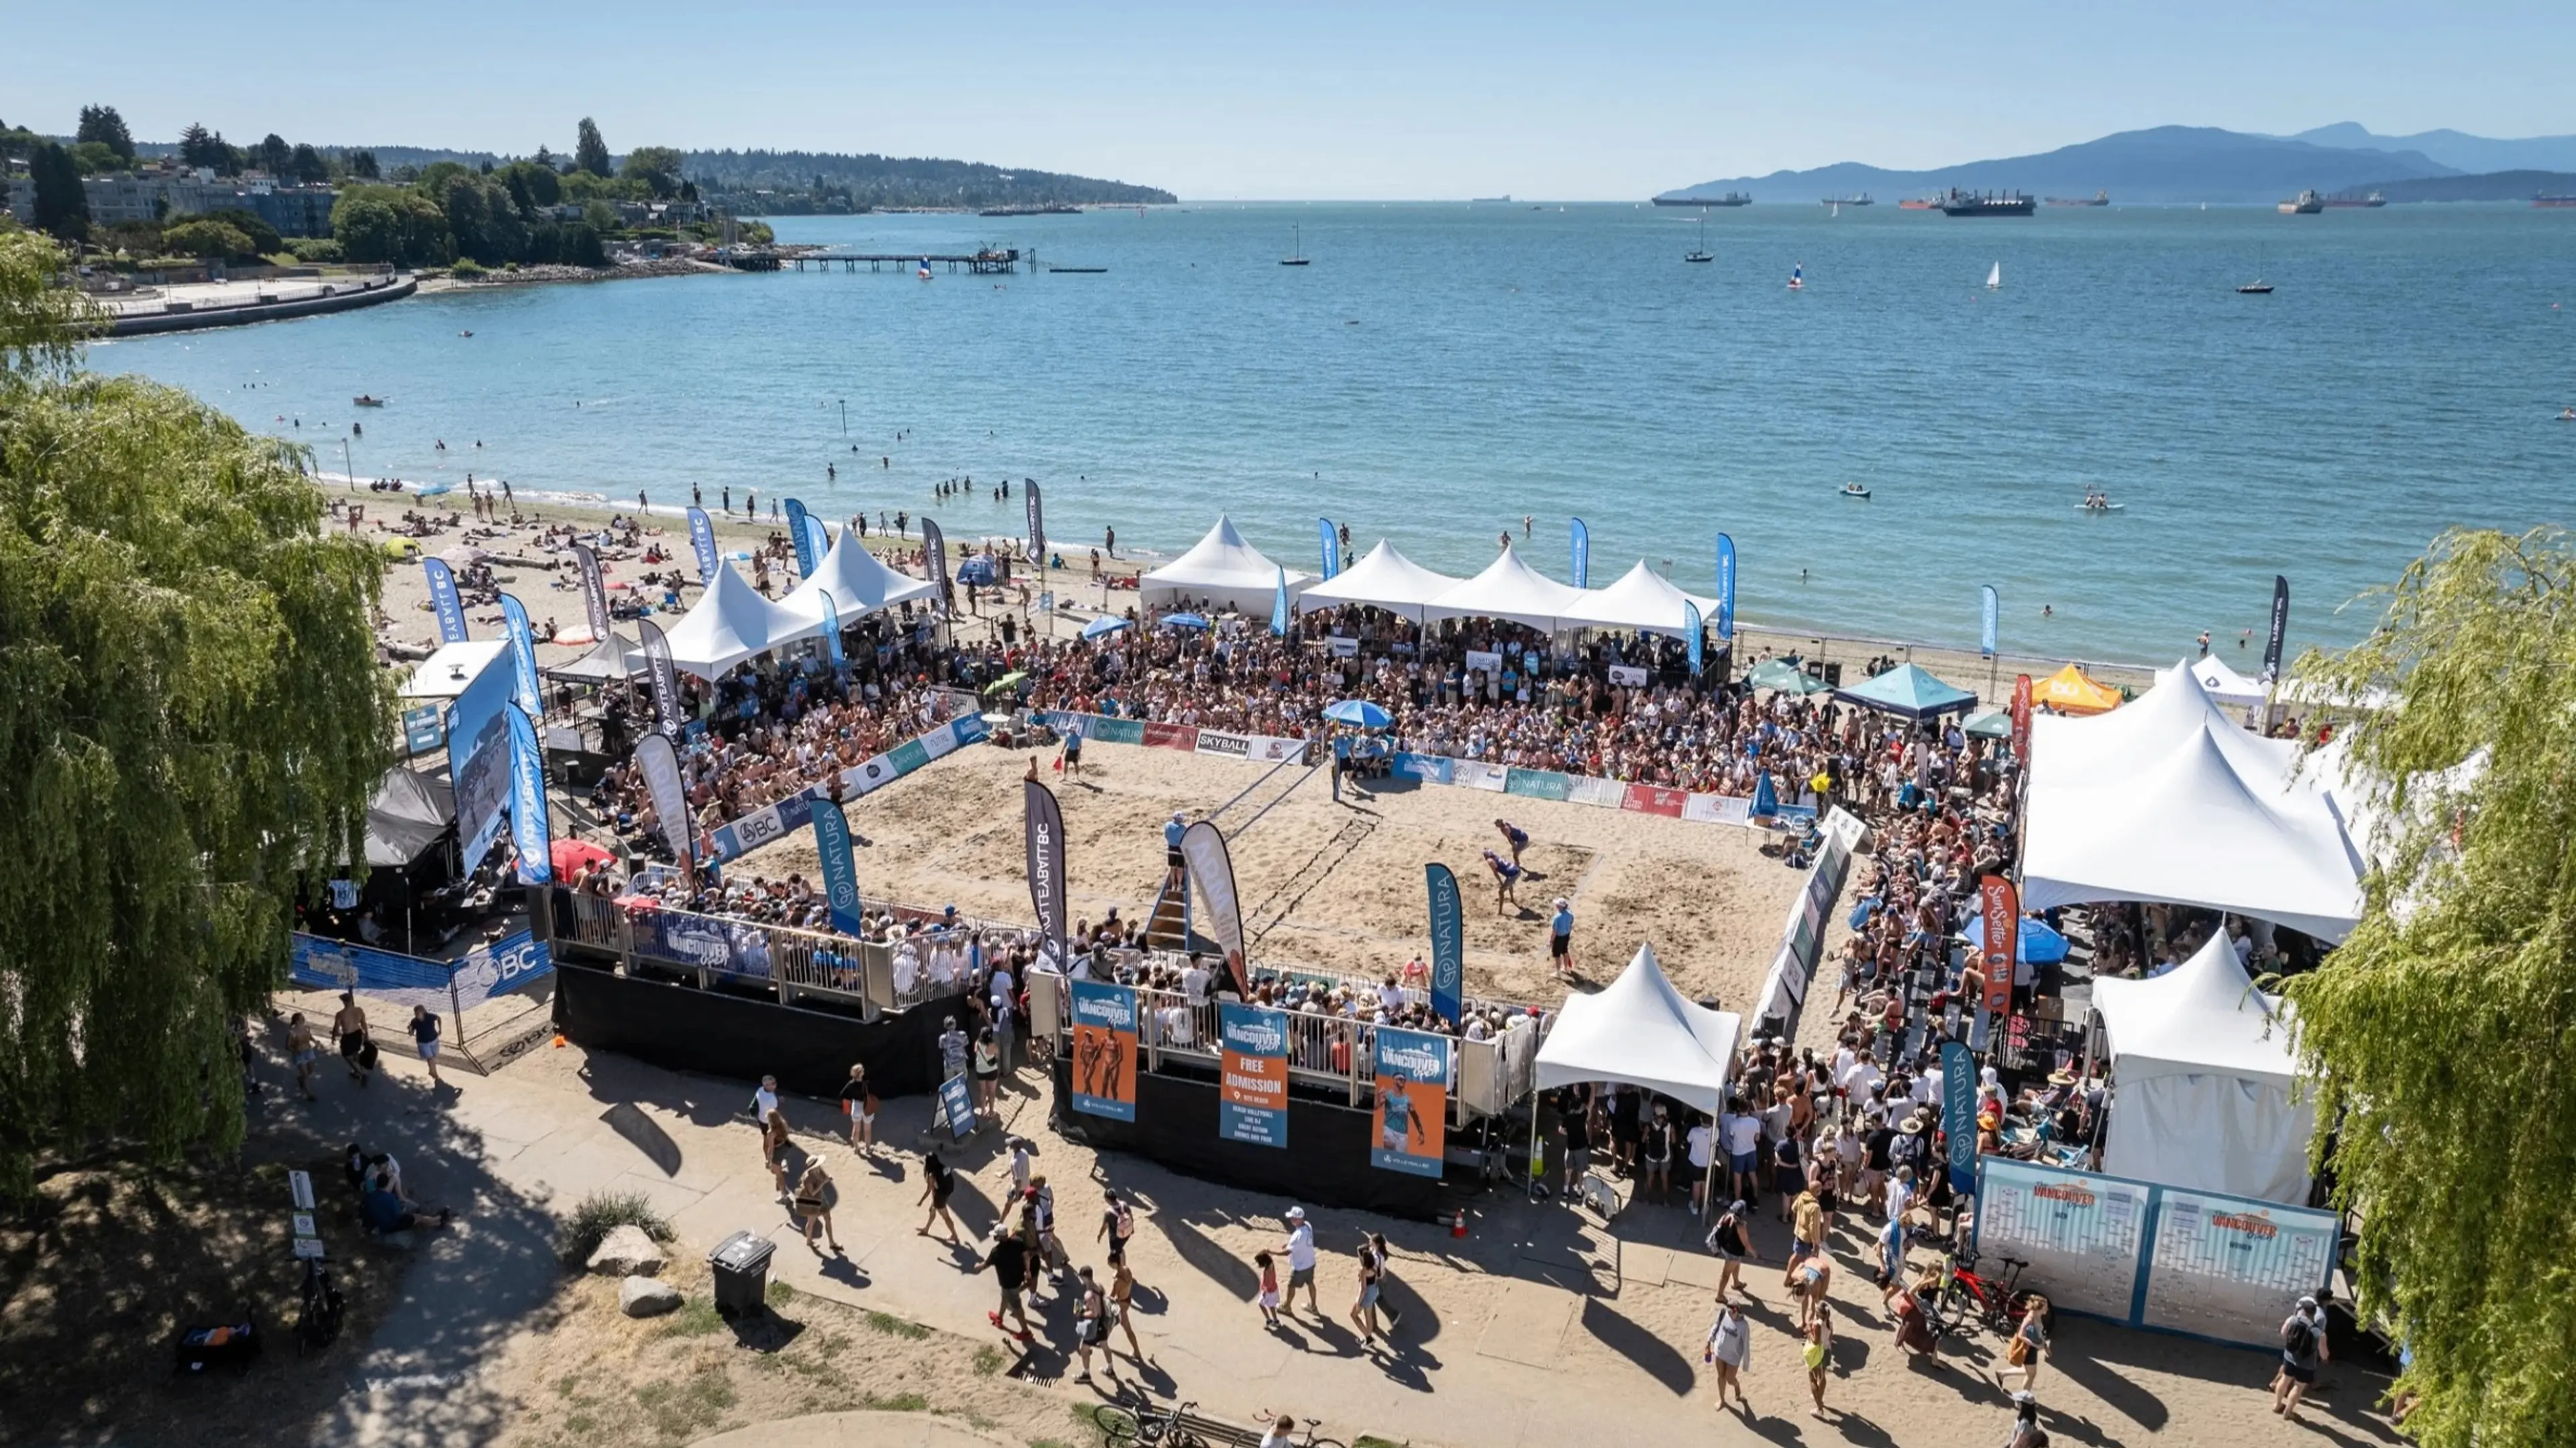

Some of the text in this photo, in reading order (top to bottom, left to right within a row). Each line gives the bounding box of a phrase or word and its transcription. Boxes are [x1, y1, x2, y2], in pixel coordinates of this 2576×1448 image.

[793, 521, 810, 570] NATURA
[1199, 736, 1247, 751] SKYBALL
[1522, 780, 1563, 792] NATURA
[790, 800, 813, 817] NATU
[753, 816, 778, 838] BC
[823, 807, 846, 880] NATURA
[1438, 874, 1452, 955] NATURA
[667, 931, 729, 959] VANCOUVER
[501, 946, 537, 980] BC
[1078, 1002, 1130, 1021] VANCOUVER
[1227, 1026, 1281, 1045] VANCOUVER
[1240, 1057, 1265, 1073] FREE
[1382, 1050, 1440, 1072] VANCOUVER
[1226, 1072, 1282, 1094] ADMISSION
[1953, 1048, 1967, 1133] NATURA
[2034, 1186, 2095, 1206] VANCOUVER
[2212, 1214, 2278, 1237] VANCOUVER
